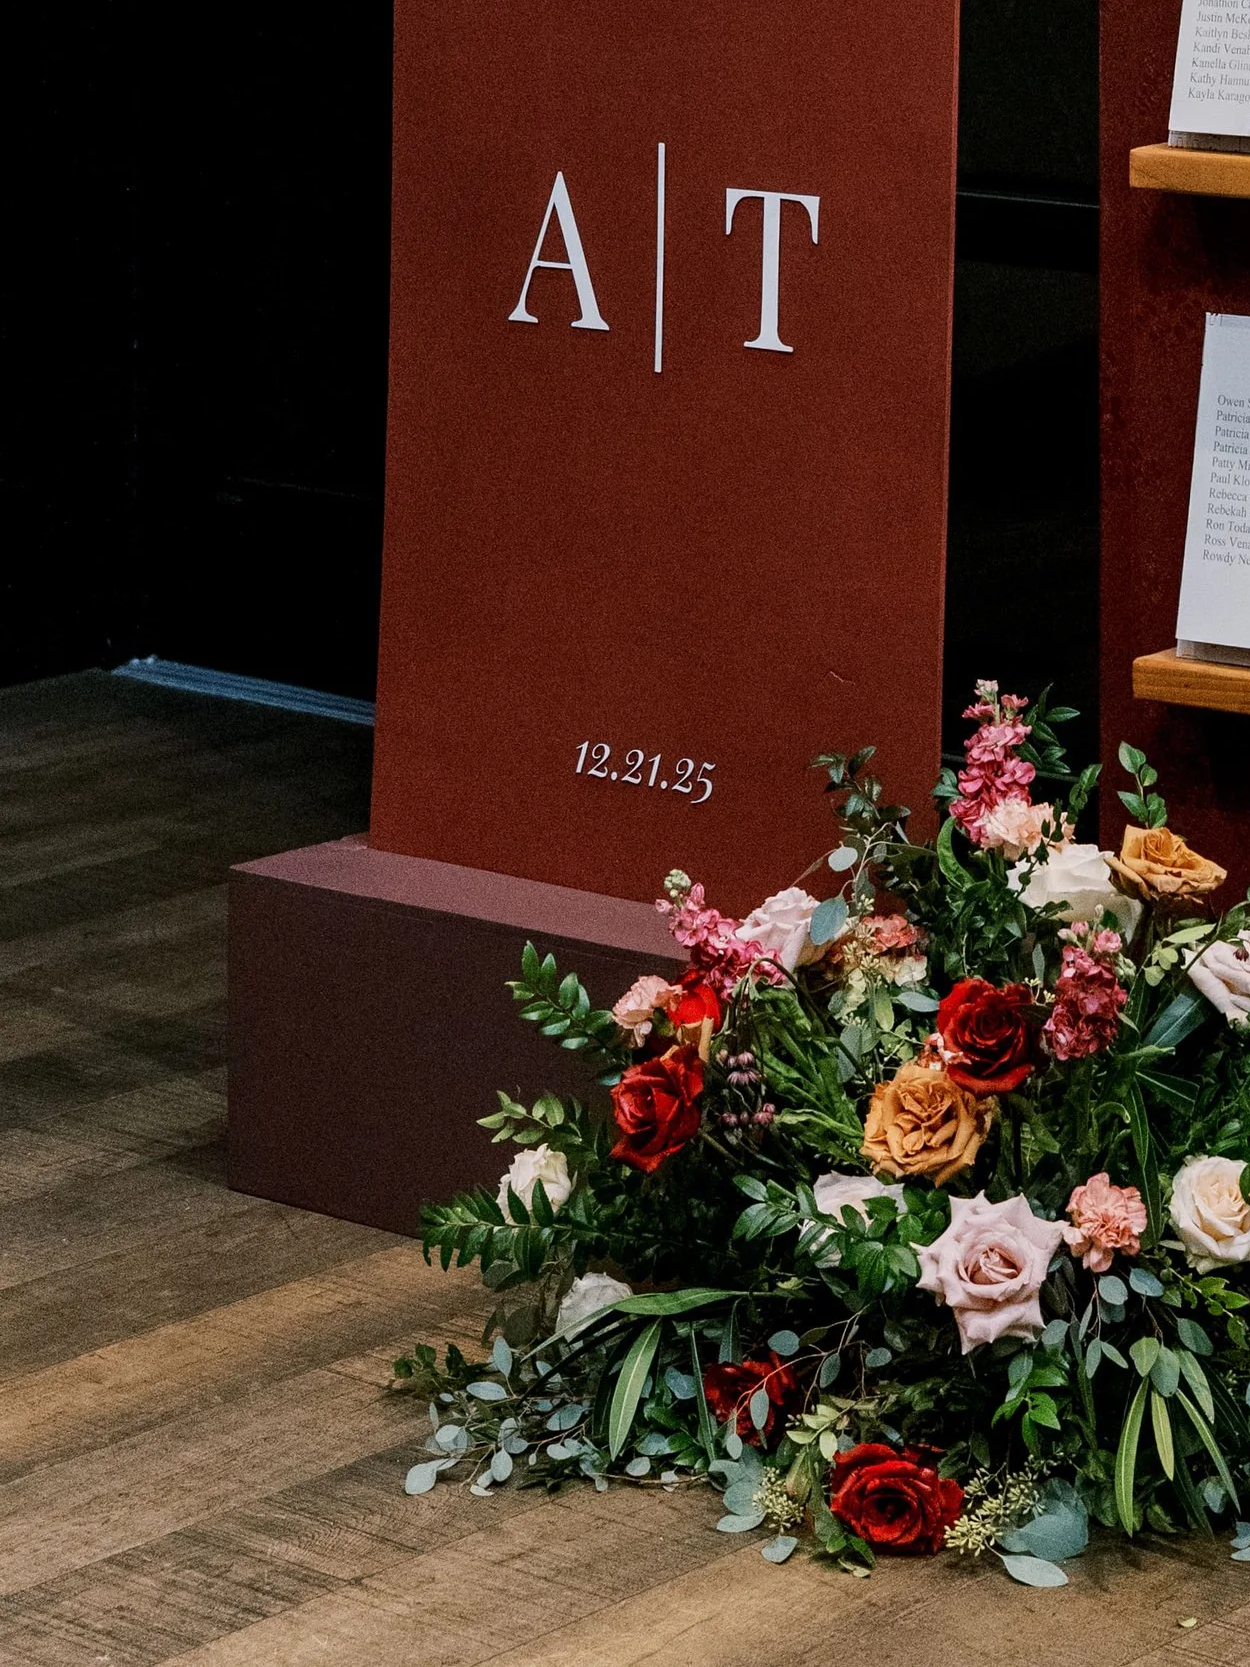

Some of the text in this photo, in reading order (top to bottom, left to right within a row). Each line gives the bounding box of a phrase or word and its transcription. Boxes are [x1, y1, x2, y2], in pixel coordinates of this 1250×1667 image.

[1197, 12, 1223, 23] Justin
[1190, 73, 1216, 86] Kathy
[1218, 395, 1245, 408] Owen
[1216, 410, 1250, 424] Patricia
[1215, 426, 1249, 440] Patricia
[1213, 441, 1248, 454] Patricia
[1206, 519, 1225, 531] Ron
[1202, 550, 1234, 565] Rowdy
[575, 741, 716, 803] 12.21.25
